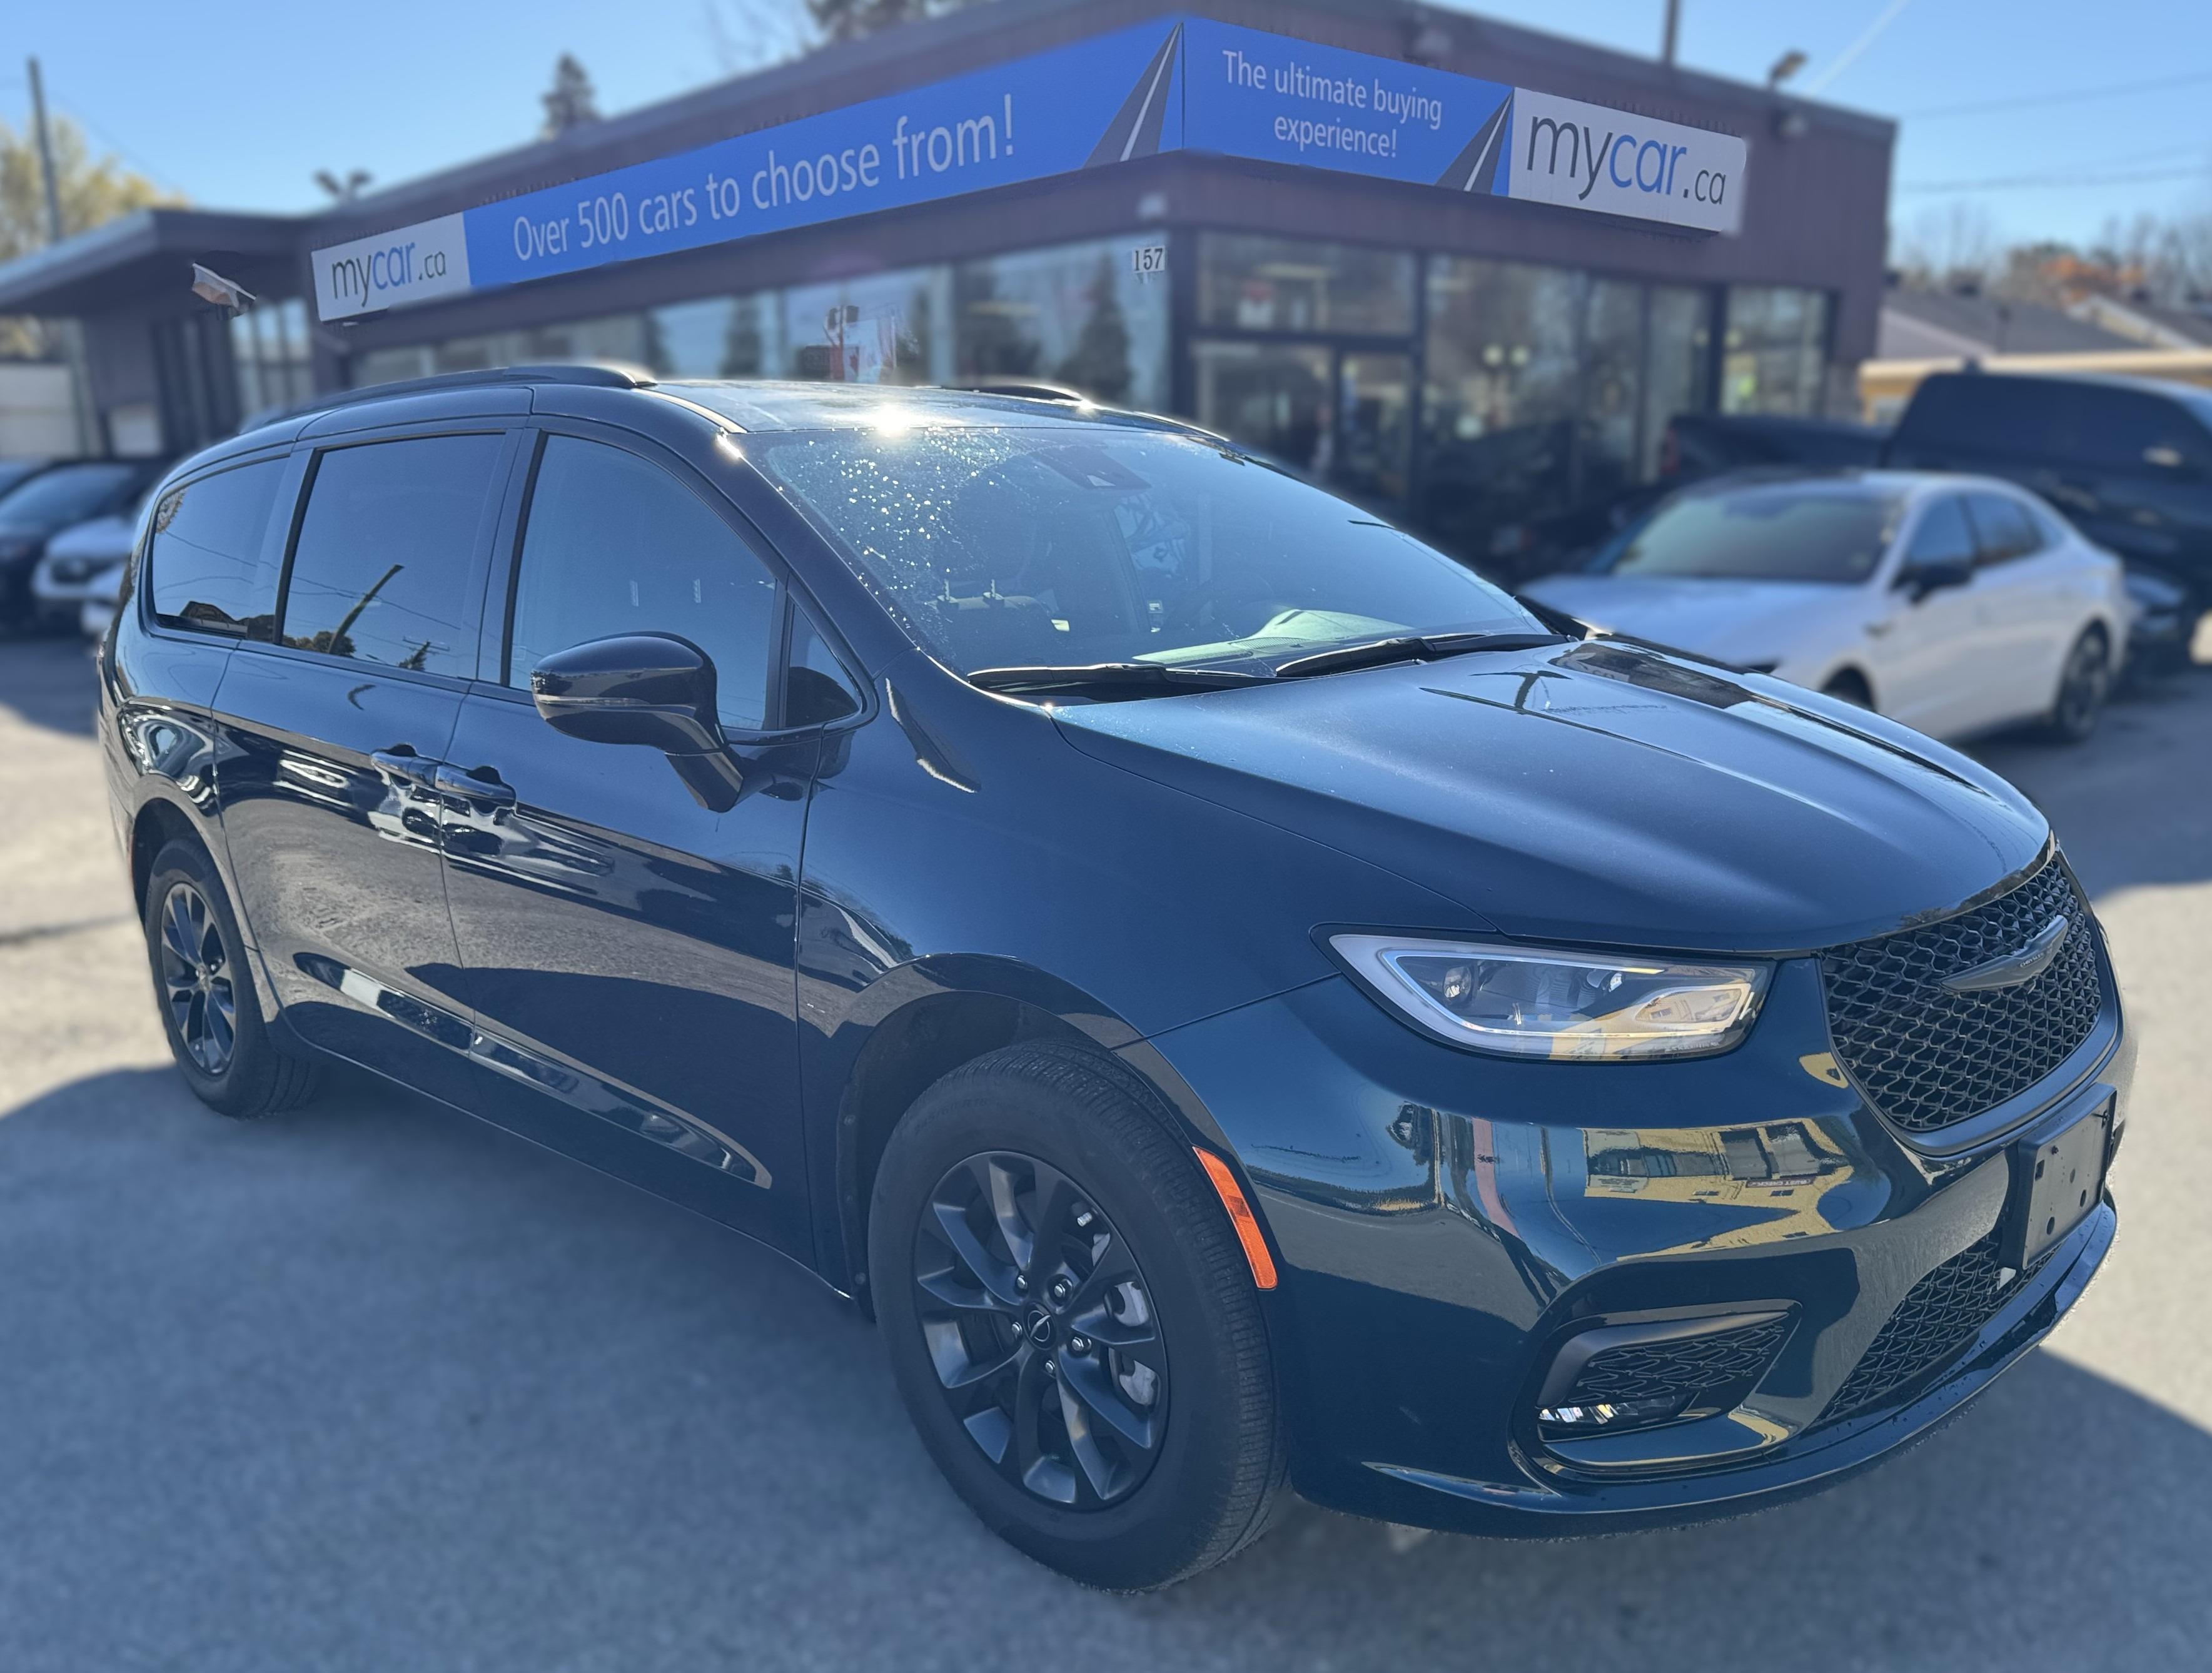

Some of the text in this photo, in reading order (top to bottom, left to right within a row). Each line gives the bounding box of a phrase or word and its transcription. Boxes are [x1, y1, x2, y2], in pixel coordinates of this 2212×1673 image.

[1222, 49, 1442, 130] The ultimate buying
[1274, 116, 1396, 158] experience!
[1527, 116, 1726, 205] mycar.ca
[513, 93, 1014, 261] Over 500 cars to choose from!
[331, 241, 447, 308] mycar.ca
[1134, 248, 1163, 271] 157
